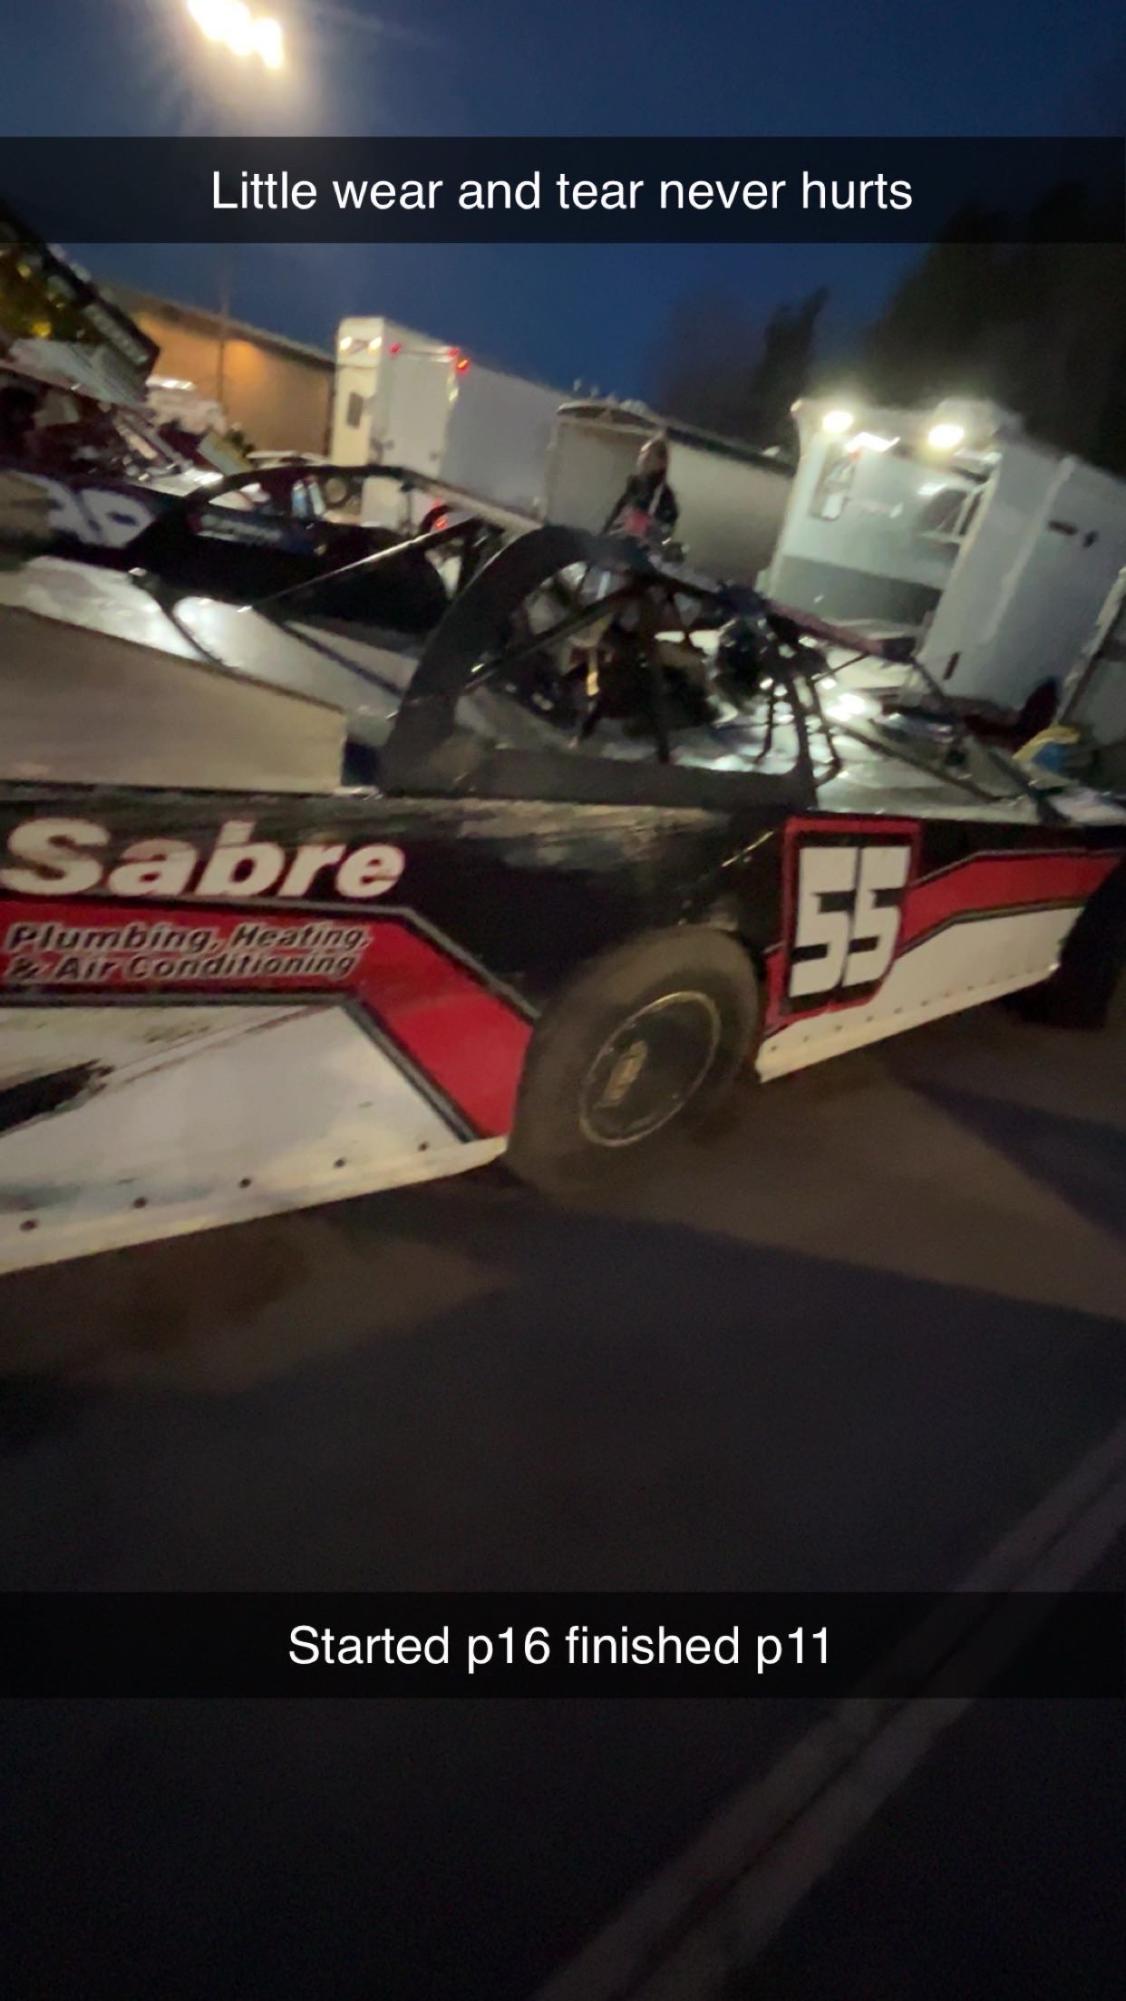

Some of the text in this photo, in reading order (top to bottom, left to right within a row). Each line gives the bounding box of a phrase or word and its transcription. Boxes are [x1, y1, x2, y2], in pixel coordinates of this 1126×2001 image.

[1, 817, 405, 898] Sabre
[7, 922, 374, 953] Plumbing, Heating,
[789, 846, 911, 998] 55
[6, 953, 362, 981] & Air Conditioning
